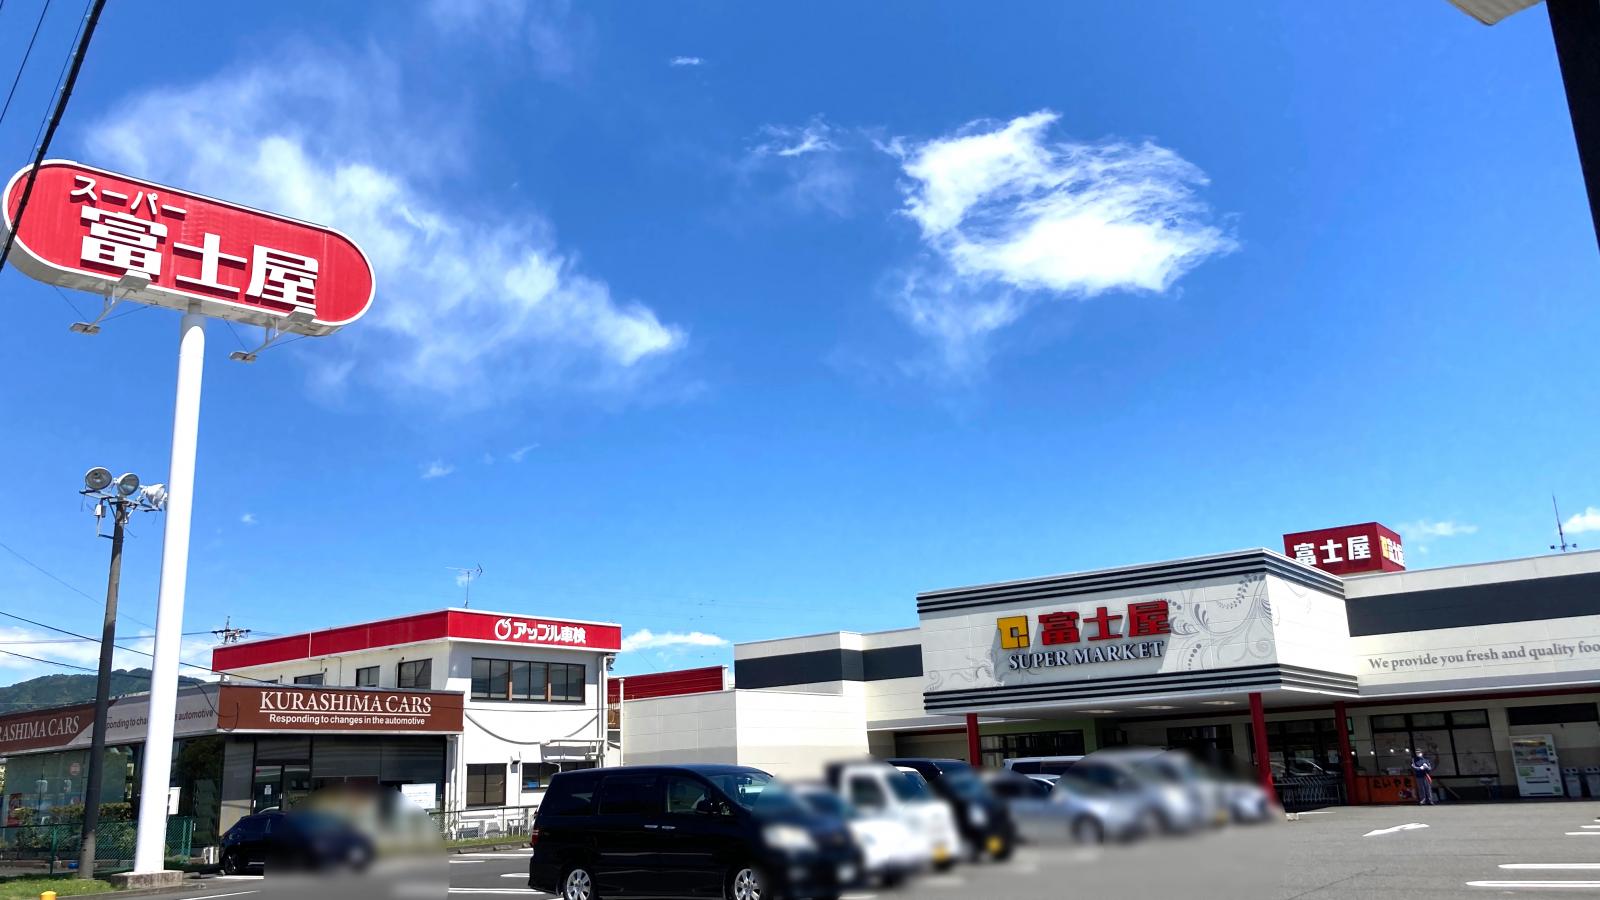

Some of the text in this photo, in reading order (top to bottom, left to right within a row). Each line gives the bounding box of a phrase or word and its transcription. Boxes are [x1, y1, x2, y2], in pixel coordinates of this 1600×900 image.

[70, 175, 187, 215] スーパー
[80, 205, 318, 310] 富士屋
[1293, 535, 1371, 565] 富士屋
[513, 621, 586, 644] アップル車検
[1038, 600, 1171, 645] 富士屋
[1008, 640, 1164, 670] SUPER MARKET
[1368, 658, 1389, 669] We
[1391, 653, 1438, 671] provide
[1440, 655, 1464, 667] you
[1466, 648, 1498, 661] fresh
[1501, 646, 1526, 659] and
[1528, 643, 1575, 660] quality
[178, 710, 214, 721] automotive
[259, 691, 432, 713] KURASHIMA CARS
[0, 716, 80, 742] ASHIMA CARS
[269, 713, 320, 725] Responding
[330, 715, 363, 725] changes
[372, 716, 384, 724] the
[385, 716, 425, 725] automotive
